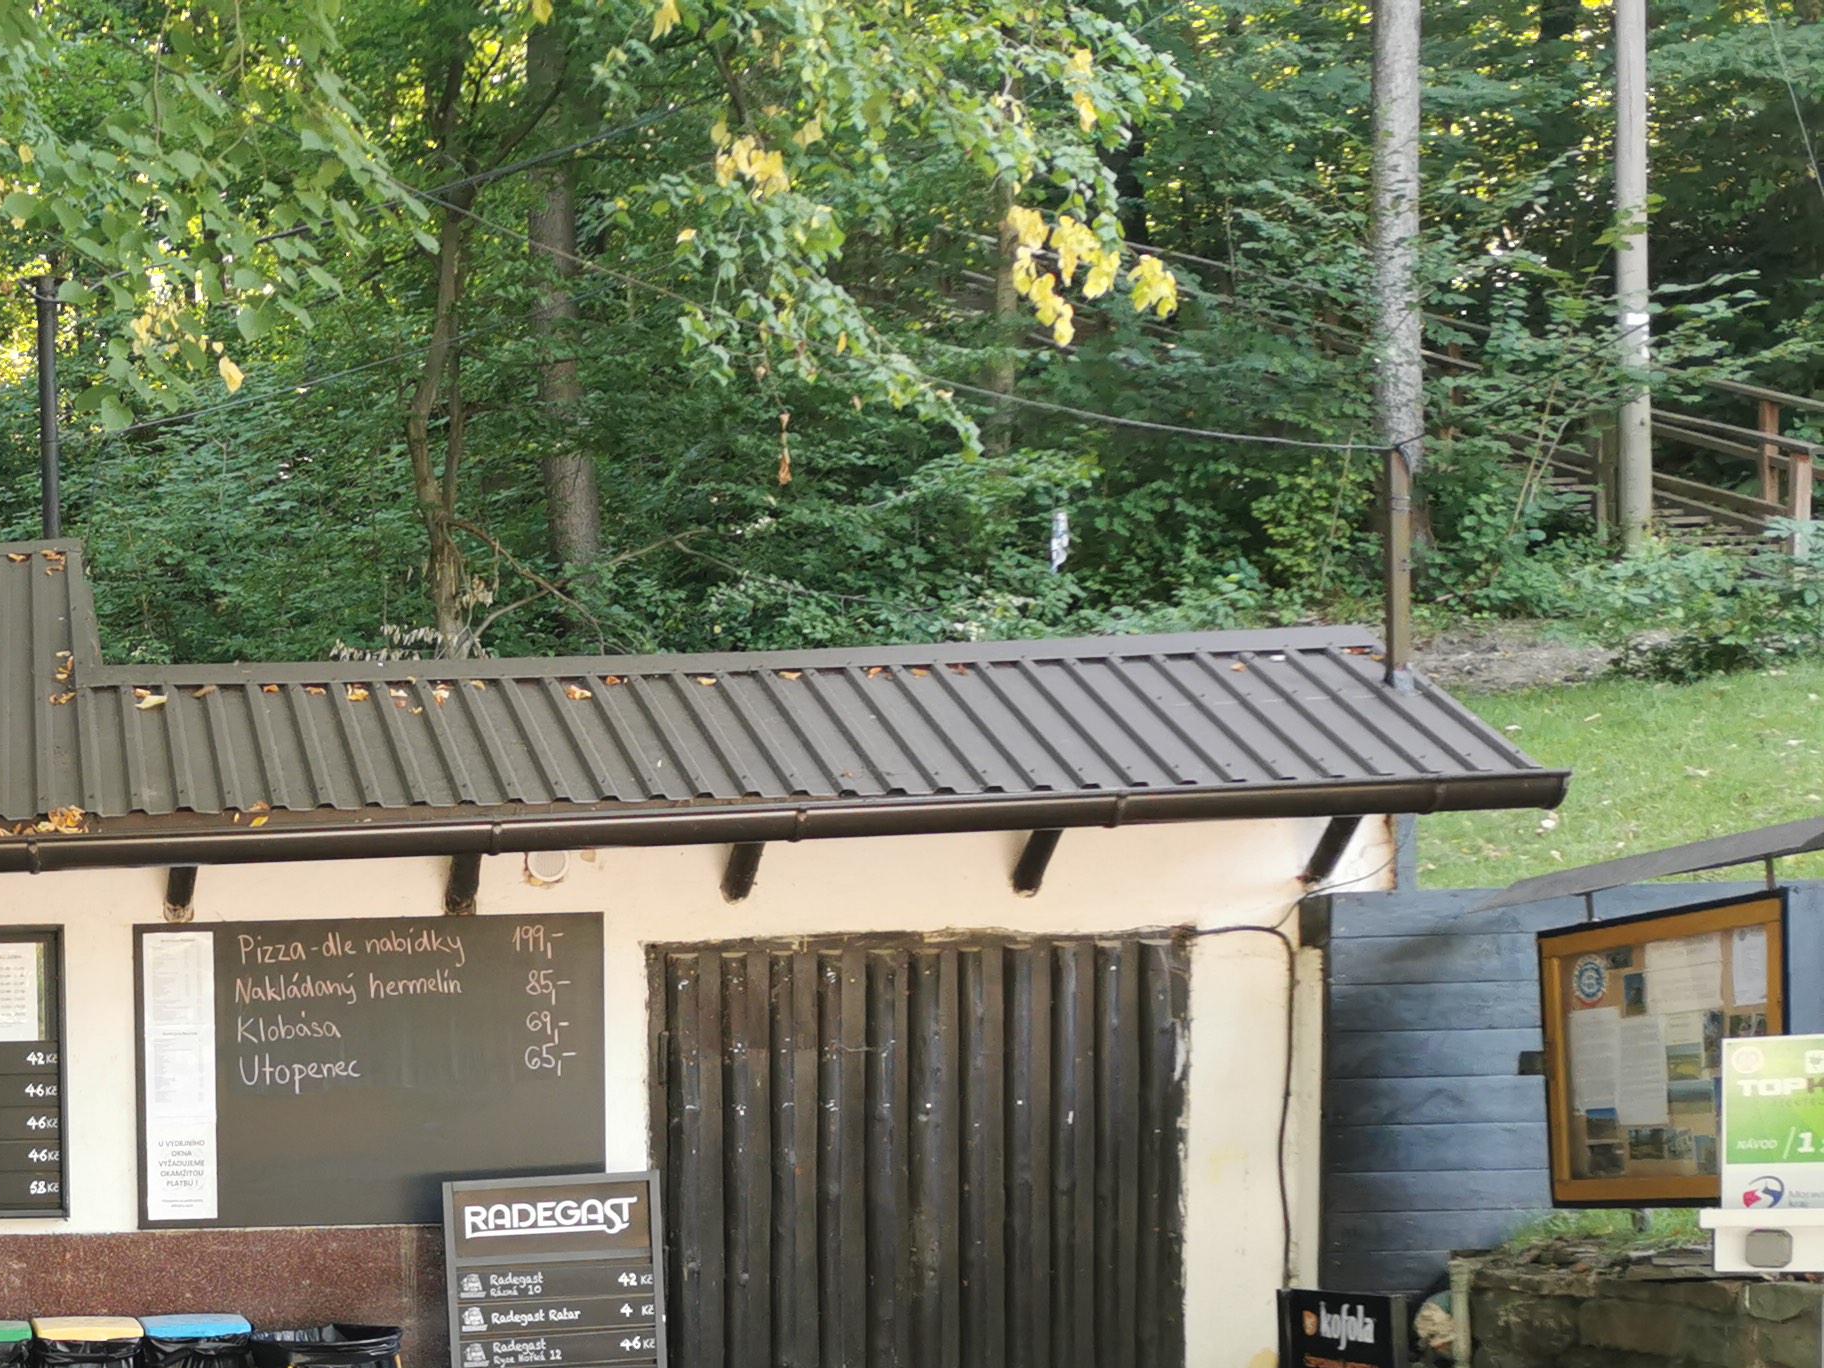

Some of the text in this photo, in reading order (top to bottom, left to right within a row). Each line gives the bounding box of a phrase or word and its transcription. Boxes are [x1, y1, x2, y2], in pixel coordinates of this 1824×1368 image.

[365, 928, 466, 968] nabídky
[512, 924, 564, 960] 199,-
[235, 972, 357, 1005] Nakládaný
[369, 968, 463, 999] hermelín
[526, 969, 571, 1006] 85,-
[237, 1010, 569, 1044] Klobása 69,-
[239, 1053, 362, 1095] Utopenec
[524, 1042, 576, 1077] 65,-
[464, 1196, 637, 1239] RADEGAST
[490, 1271, 653, 1289] Radegast 42 Kč
[528, 1285, 542, 1295] 10
[491, 1309, 545, 1326] Radegast
[549, 1307, 581, 1321] Ratar
[642, 1304, 655, 1316] Kč
[1318, 1301, 1376, 1350] kofola
[493, 1336, 656, 1355] Radegast 46 Kč
[549, 1349, 562, 1361] 12
